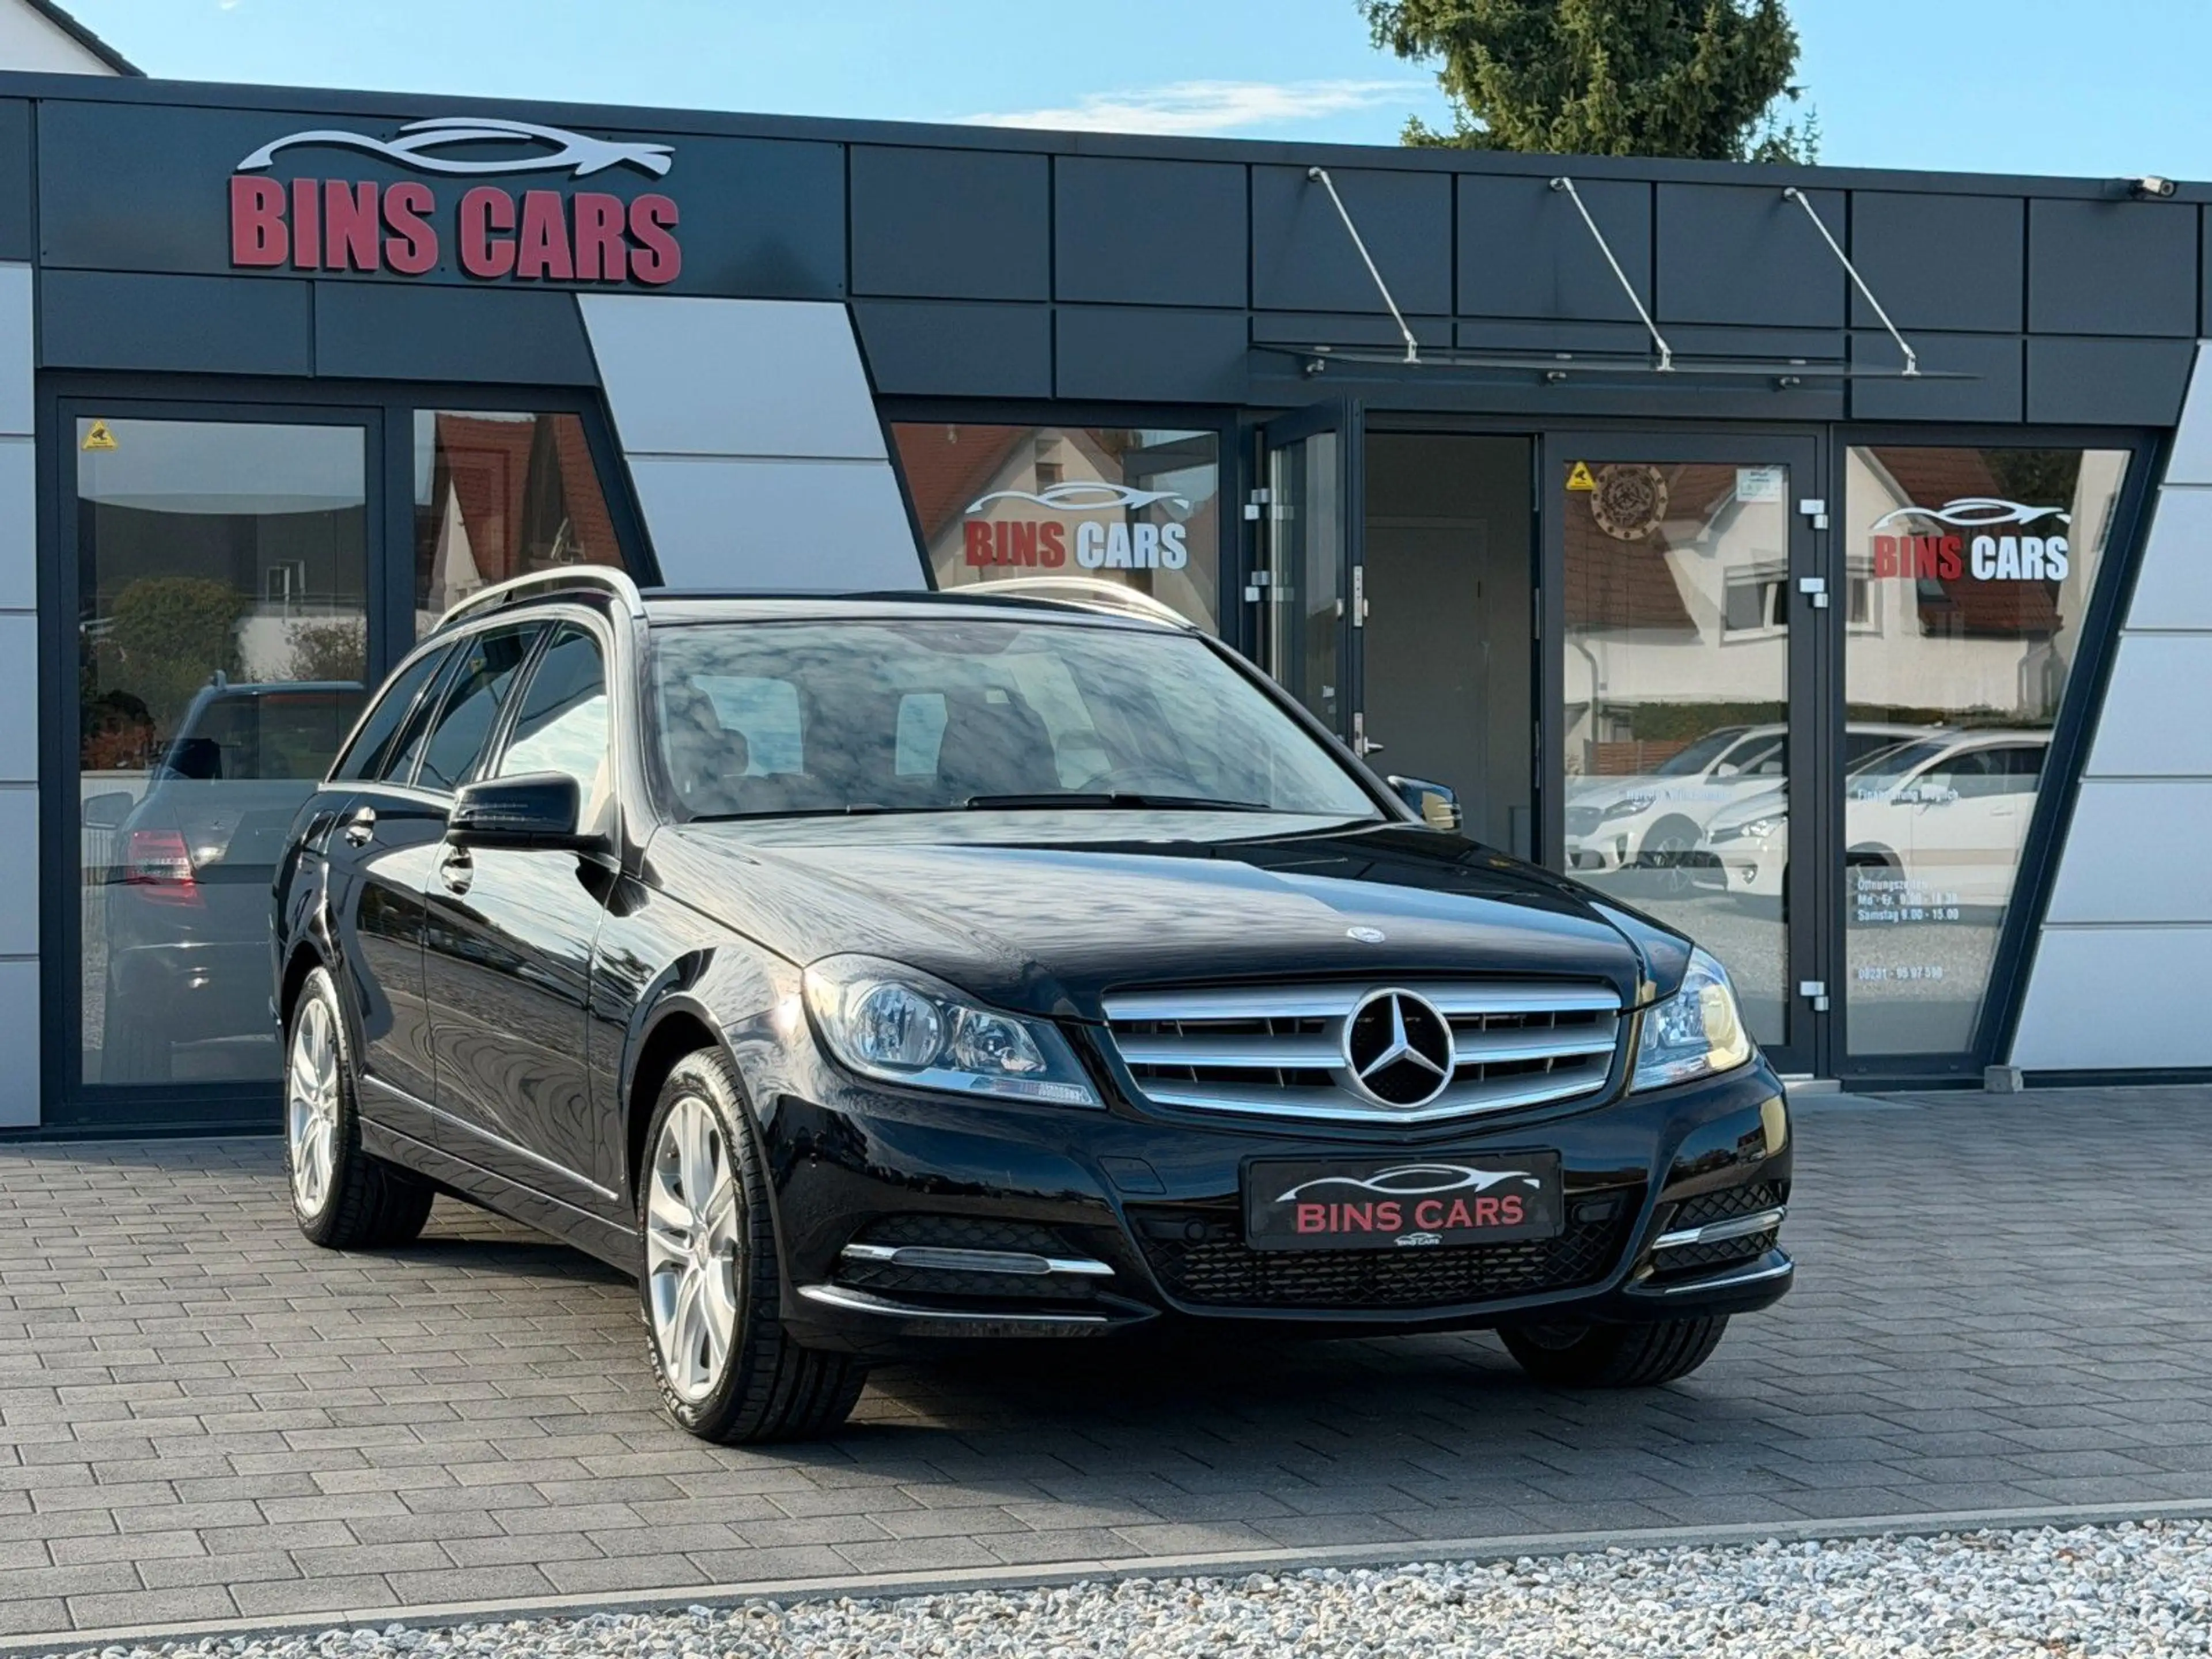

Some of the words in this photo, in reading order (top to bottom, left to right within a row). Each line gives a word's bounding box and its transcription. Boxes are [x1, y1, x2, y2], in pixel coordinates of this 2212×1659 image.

[233, 176, 438, 274] BINS
[461, 186, 682, 284] CARS
[965, 520, 1066, 568] BINS
[1076, 521, 1187, 569] CARS
[1874, 535, 1963, 579] BINS
[1971, 535, 2069, 581] CARS
[1858, 909, 1899, 923] Samstag
[1296, 1201, 1403, 1233] BINS
[1415, 1195, 1524, 1230] CARS
